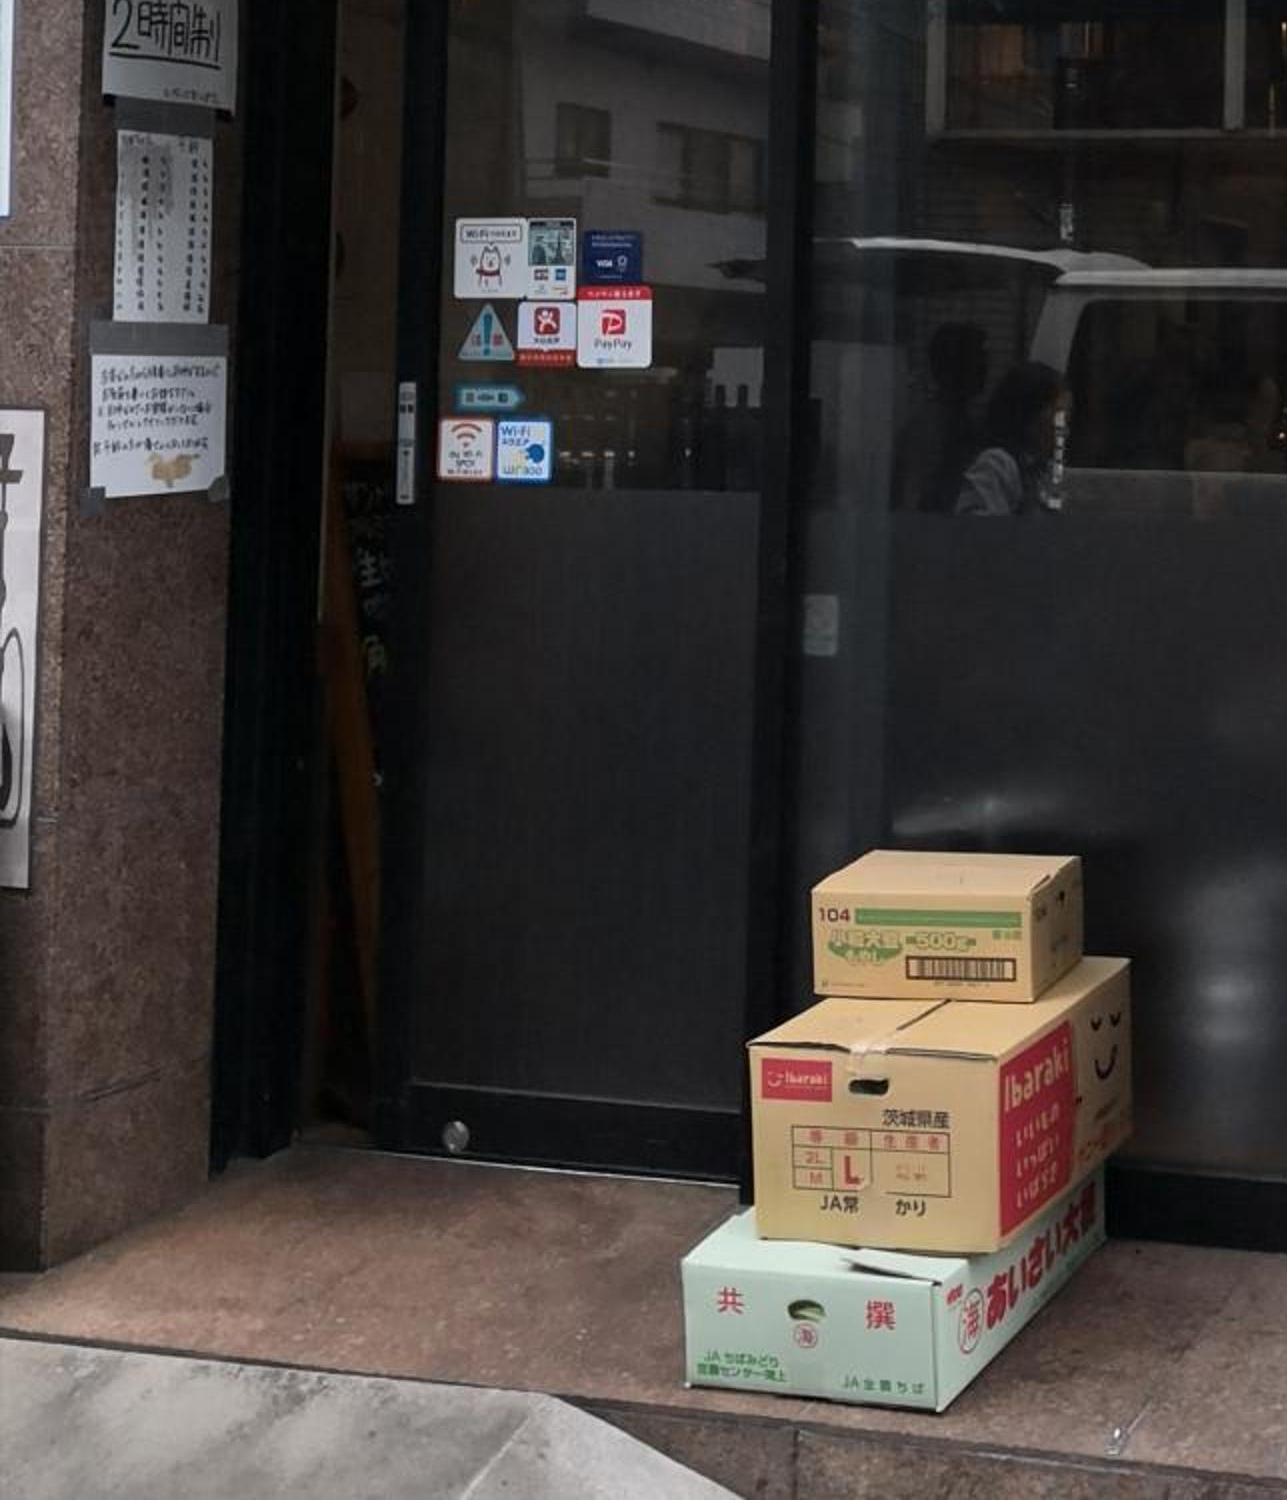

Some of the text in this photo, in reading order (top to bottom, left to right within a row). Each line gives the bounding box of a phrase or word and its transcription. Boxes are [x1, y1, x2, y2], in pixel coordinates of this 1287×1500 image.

[594, 337, 632, 351] PayPay
[819, 907, 850, 923] 104
[1003, 1037, 1069, 1114] Ibaraki
[882, 1108, 951, 1129] 茨城県産
